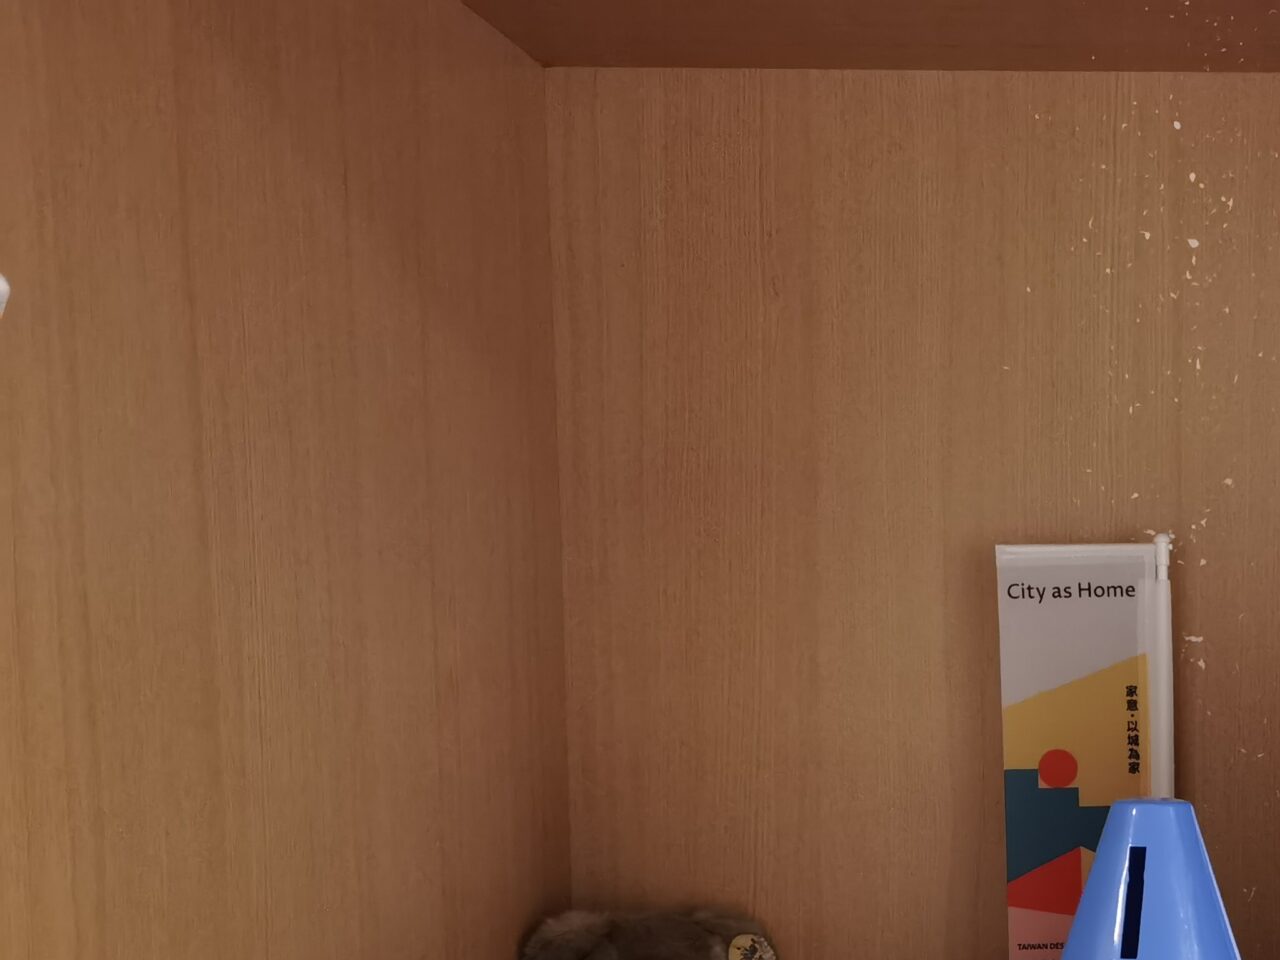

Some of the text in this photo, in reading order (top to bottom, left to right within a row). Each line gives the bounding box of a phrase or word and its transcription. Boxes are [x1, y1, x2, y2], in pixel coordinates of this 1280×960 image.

[1006, 581, 1136, 604] City as Home
[1017, 943, 1048, 951] TAIWAN
